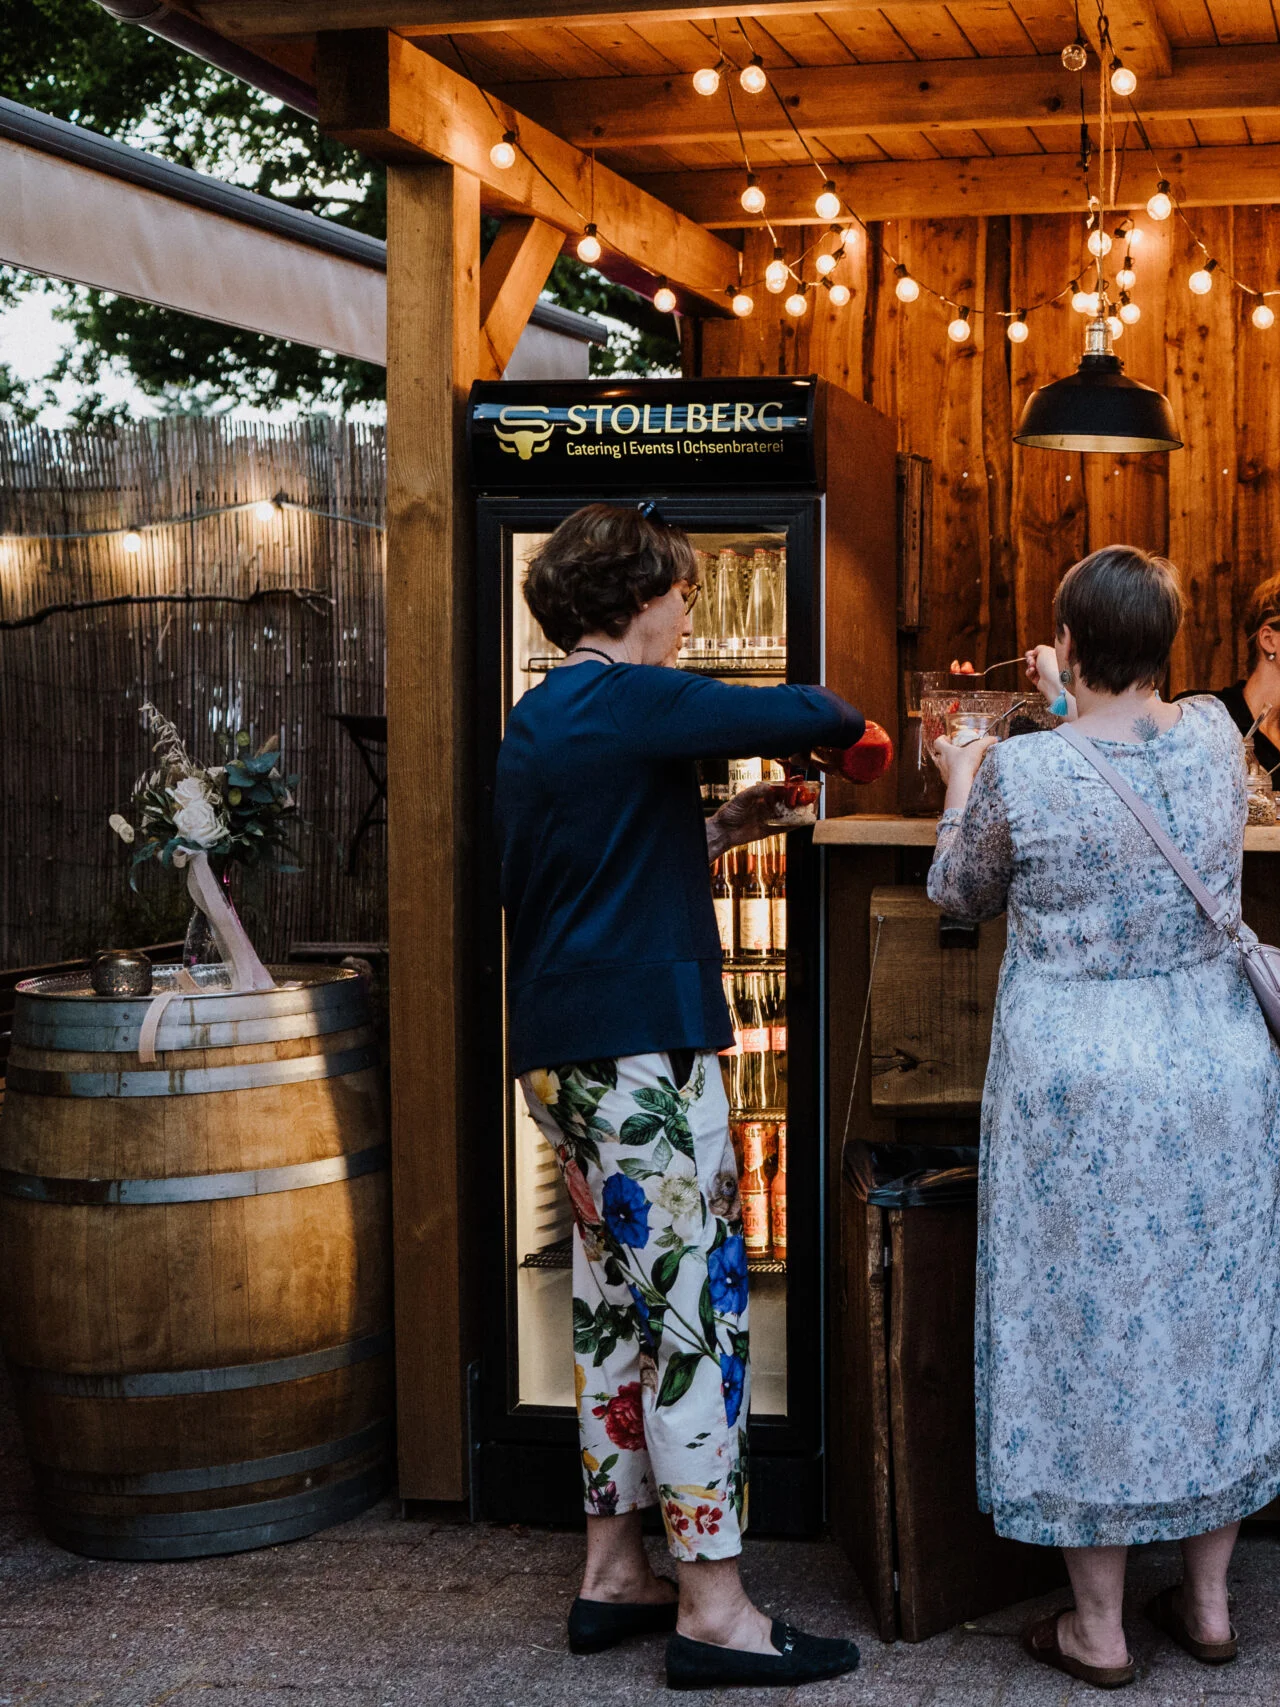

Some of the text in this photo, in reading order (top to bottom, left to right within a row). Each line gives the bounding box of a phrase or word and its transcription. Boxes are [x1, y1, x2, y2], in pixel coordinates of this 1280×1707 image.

[566, 402, 783, 435] STOLLBERG
[566, 442, 621, 459] Catering
[630, 440, 674, 455] Events
[683, 439, 784, 455] Ochsenbraterei
